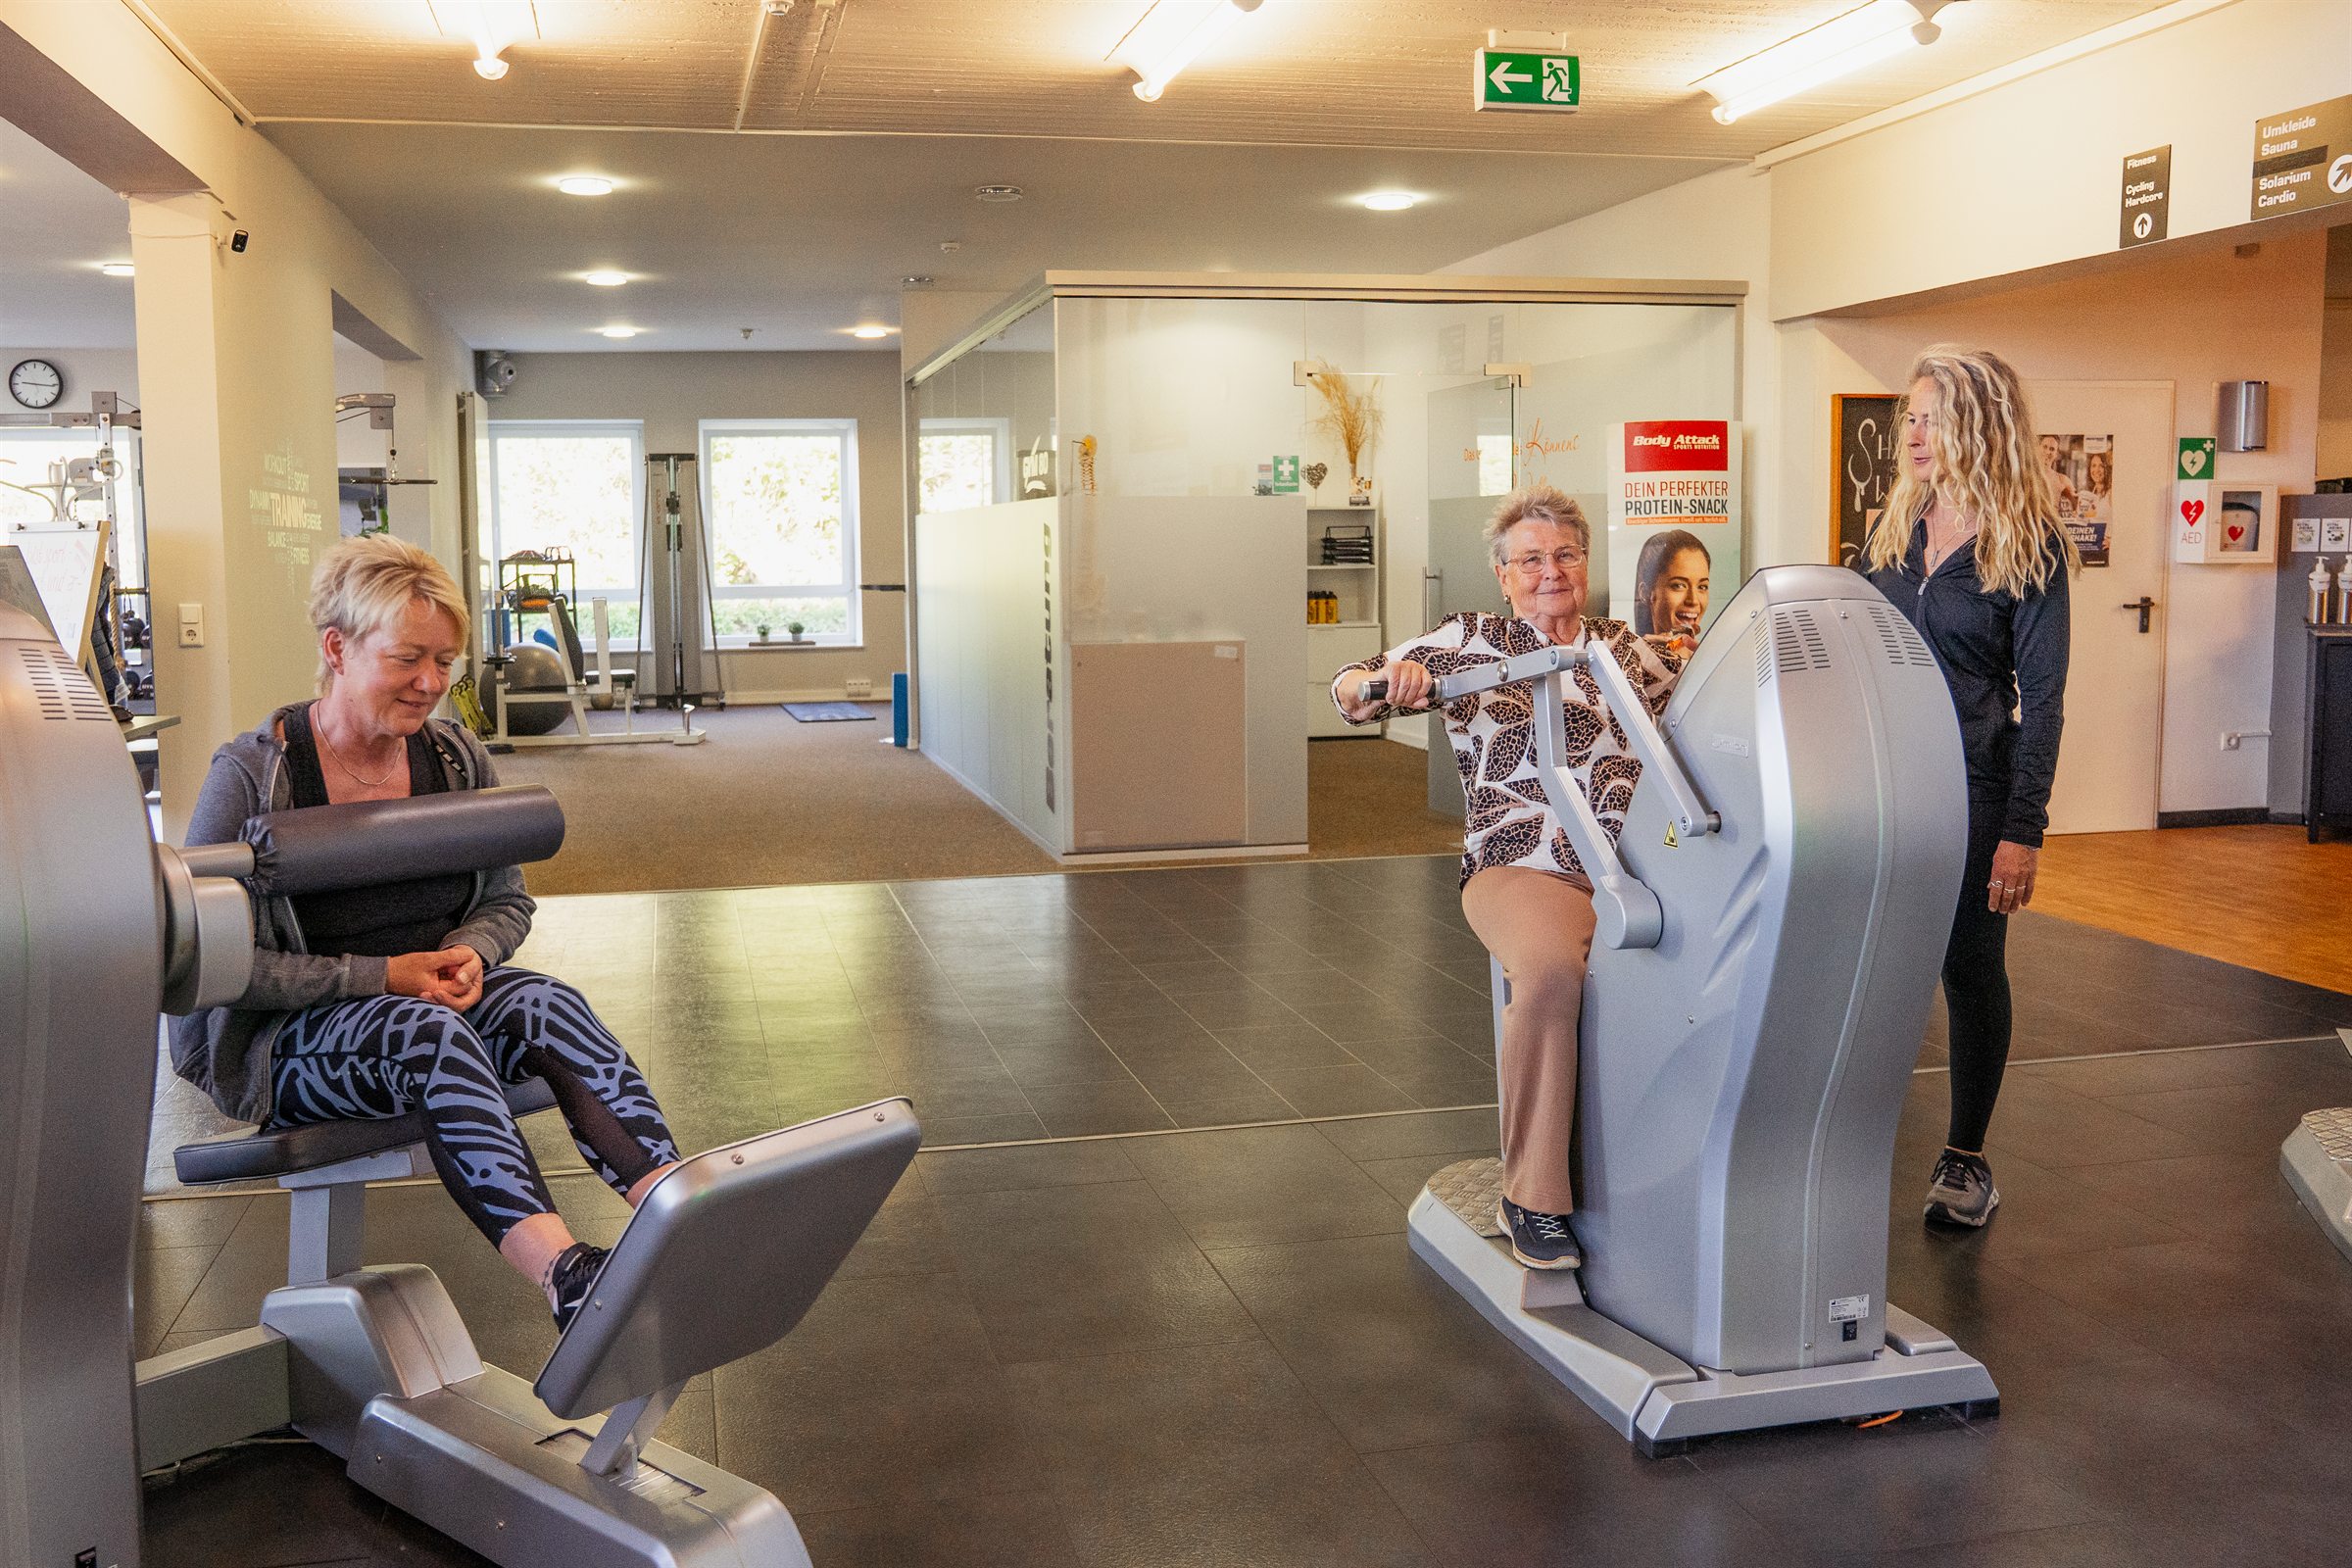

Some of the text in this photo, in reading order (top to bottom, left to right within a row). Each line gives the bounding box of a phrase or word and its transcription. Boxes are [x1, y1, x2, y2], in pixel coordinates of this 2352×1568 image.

[2263, 117, 2316, 138] Umkleide
[2261, 139, 2298, 156] Sauna
[2127, 155, 2157, 170] Fitness
[2126, 181, 2155, 196] Cycling
[2259, 171, 2311, 190] Solarium
[2125, 192, 2164, 208] Hardcore
[2258, 189, 2296, 208] Cardio
[1633, 434, 1720, 447] Body Attack
[1625, 480, 1728, 498] DEIN PERFEKTER
[270, 492, 307, 528] TRAINING
[1625, 498, 1729, 515] PROTEIN-SNACK
[2181, 532, 2202, 544] AED
